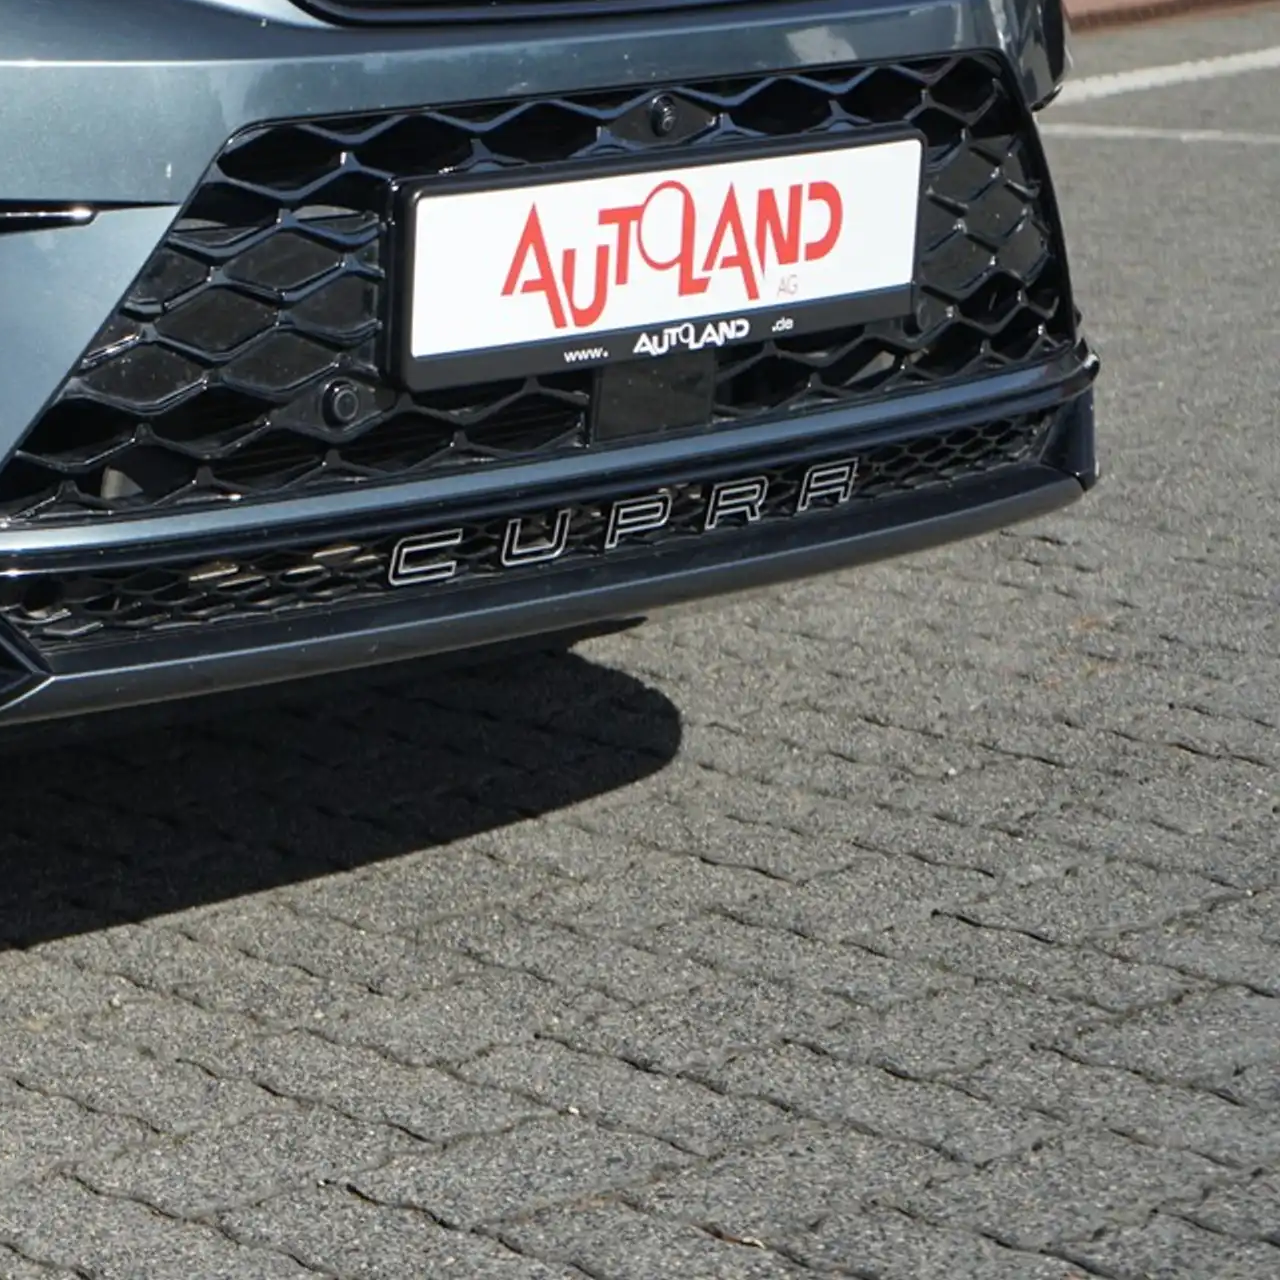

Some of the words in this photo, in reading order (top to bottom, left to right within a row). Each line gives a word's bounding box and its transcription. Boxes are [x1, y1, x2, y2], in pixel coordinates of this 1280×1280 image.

[500, 179, 844, 329] AUTOLAND
[776, 273, 799, 298] AG
[632, 317, 751, 357] AUTOLAND
[388, 457, 860, 587] CUPRA
